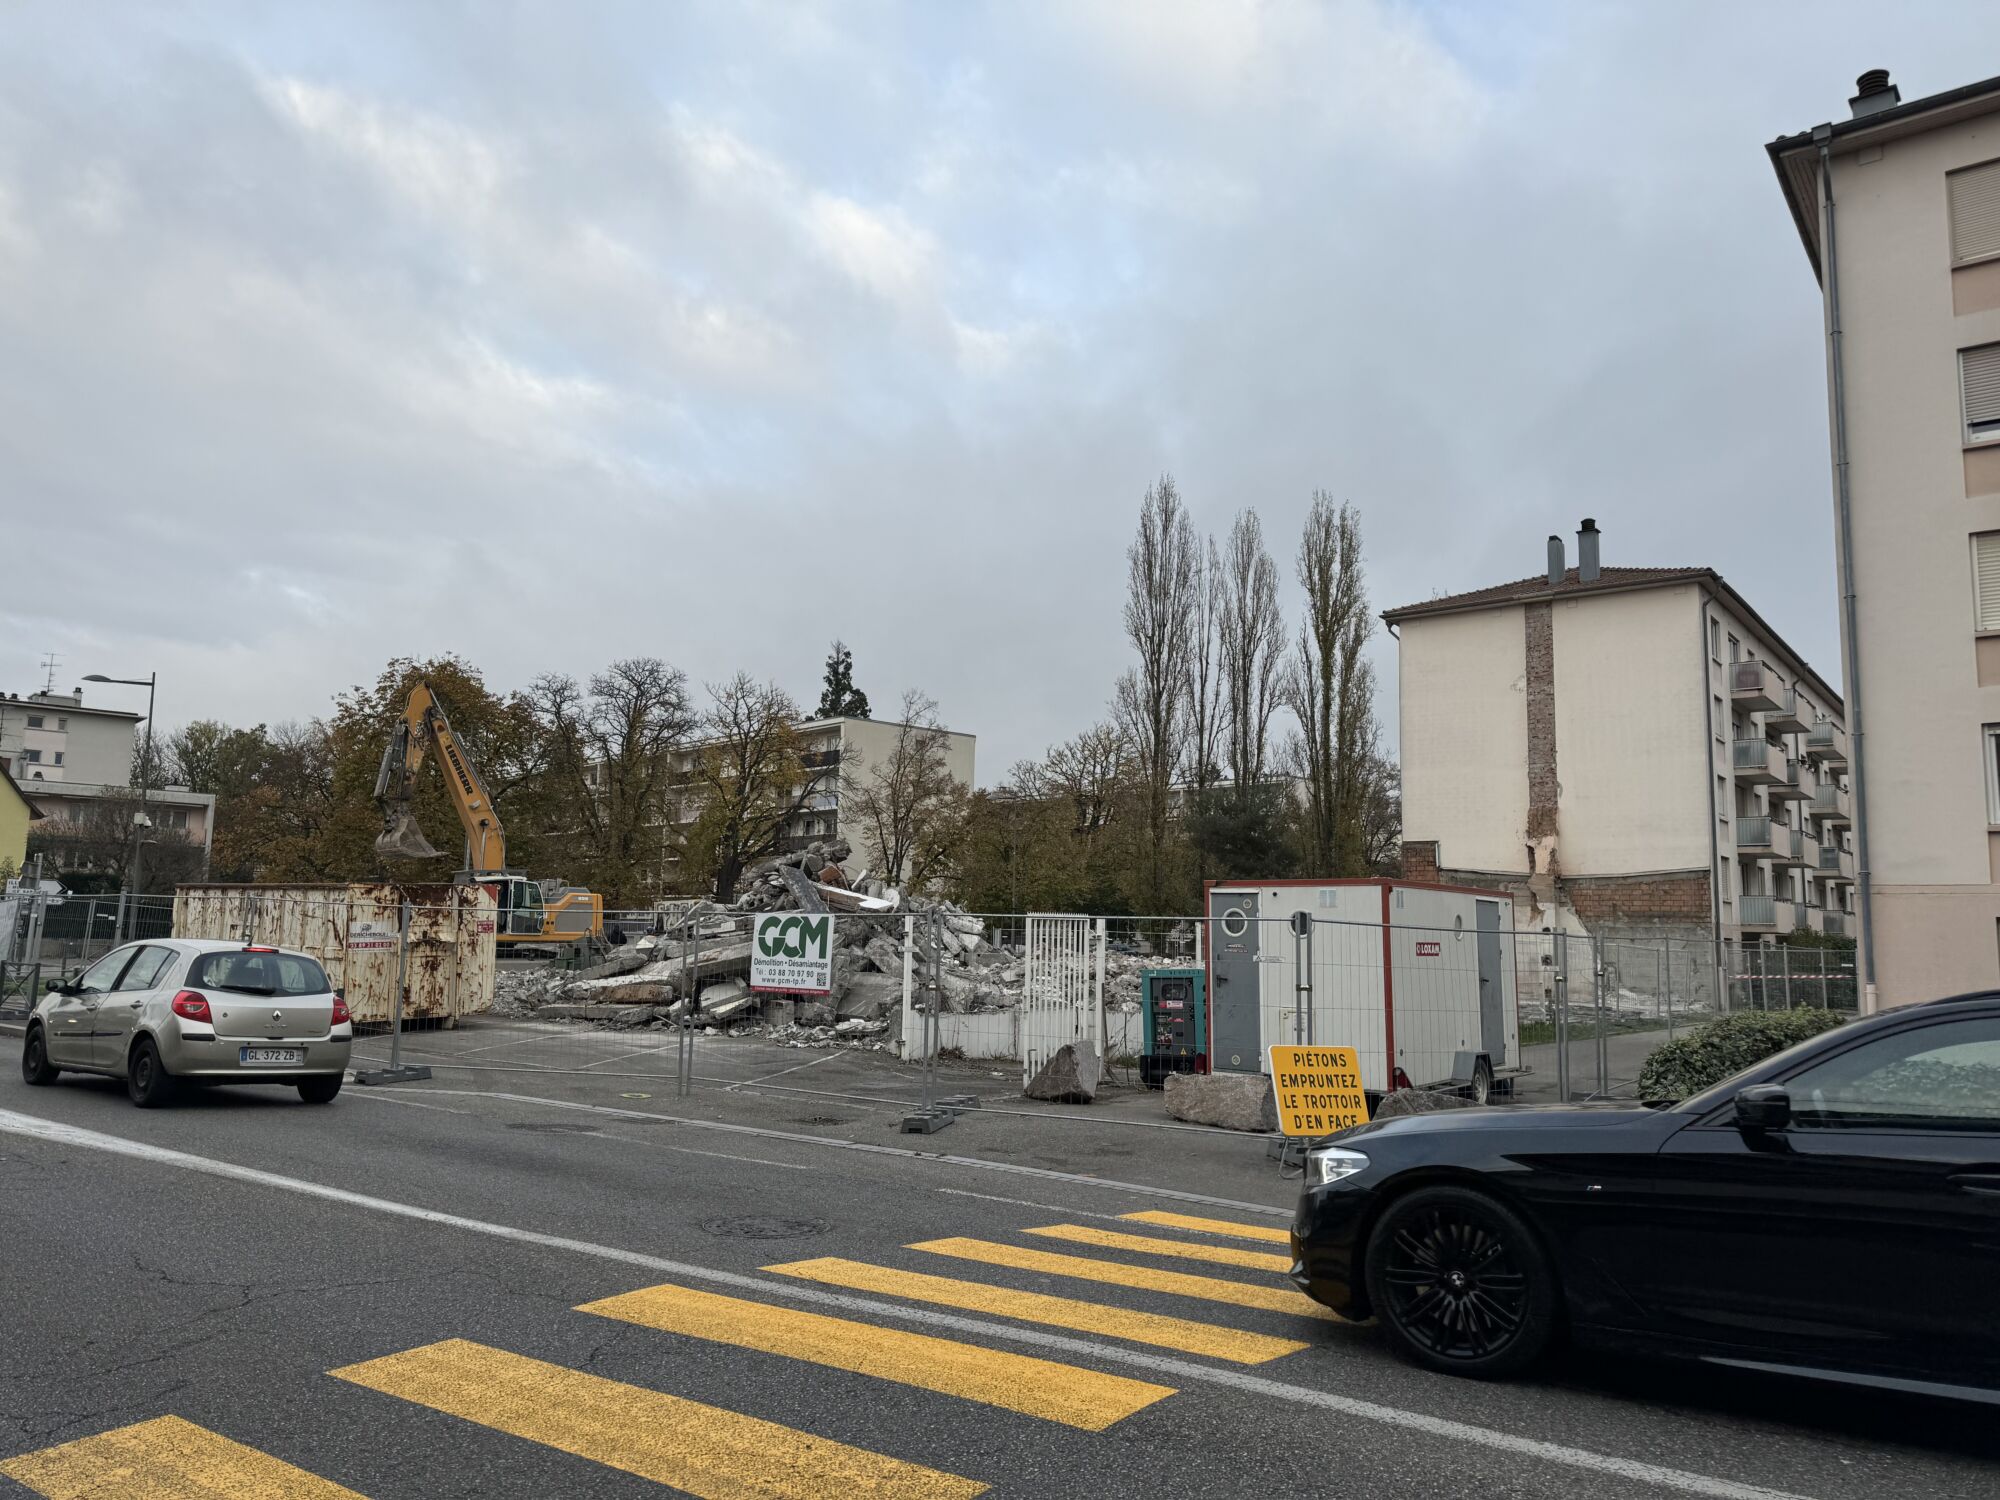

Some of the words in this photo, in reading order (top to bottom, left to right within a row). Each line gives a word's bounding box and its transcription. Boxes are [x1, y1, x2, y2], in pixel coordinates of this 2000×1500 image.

[445, 744, 474, 796] LIEBHERR
[758, 916, 829, 959] GCM
[754, 958, 783, 967] Démolition
[788, 959, 828, 970] Désamiantage
[761, 977, 806, 986] www.gcm-tp.fr
[1293, 1051, 1347, 1067] PIÉTONS
[1281, 1074, 1357, 1088] EMPRUNTEZ
[1284, 1094, 1298, 1108] LE
[1303, 1094, 1361, 1109] TROTTOIR
[1294, 1115, 1323, 1129] D'EN
